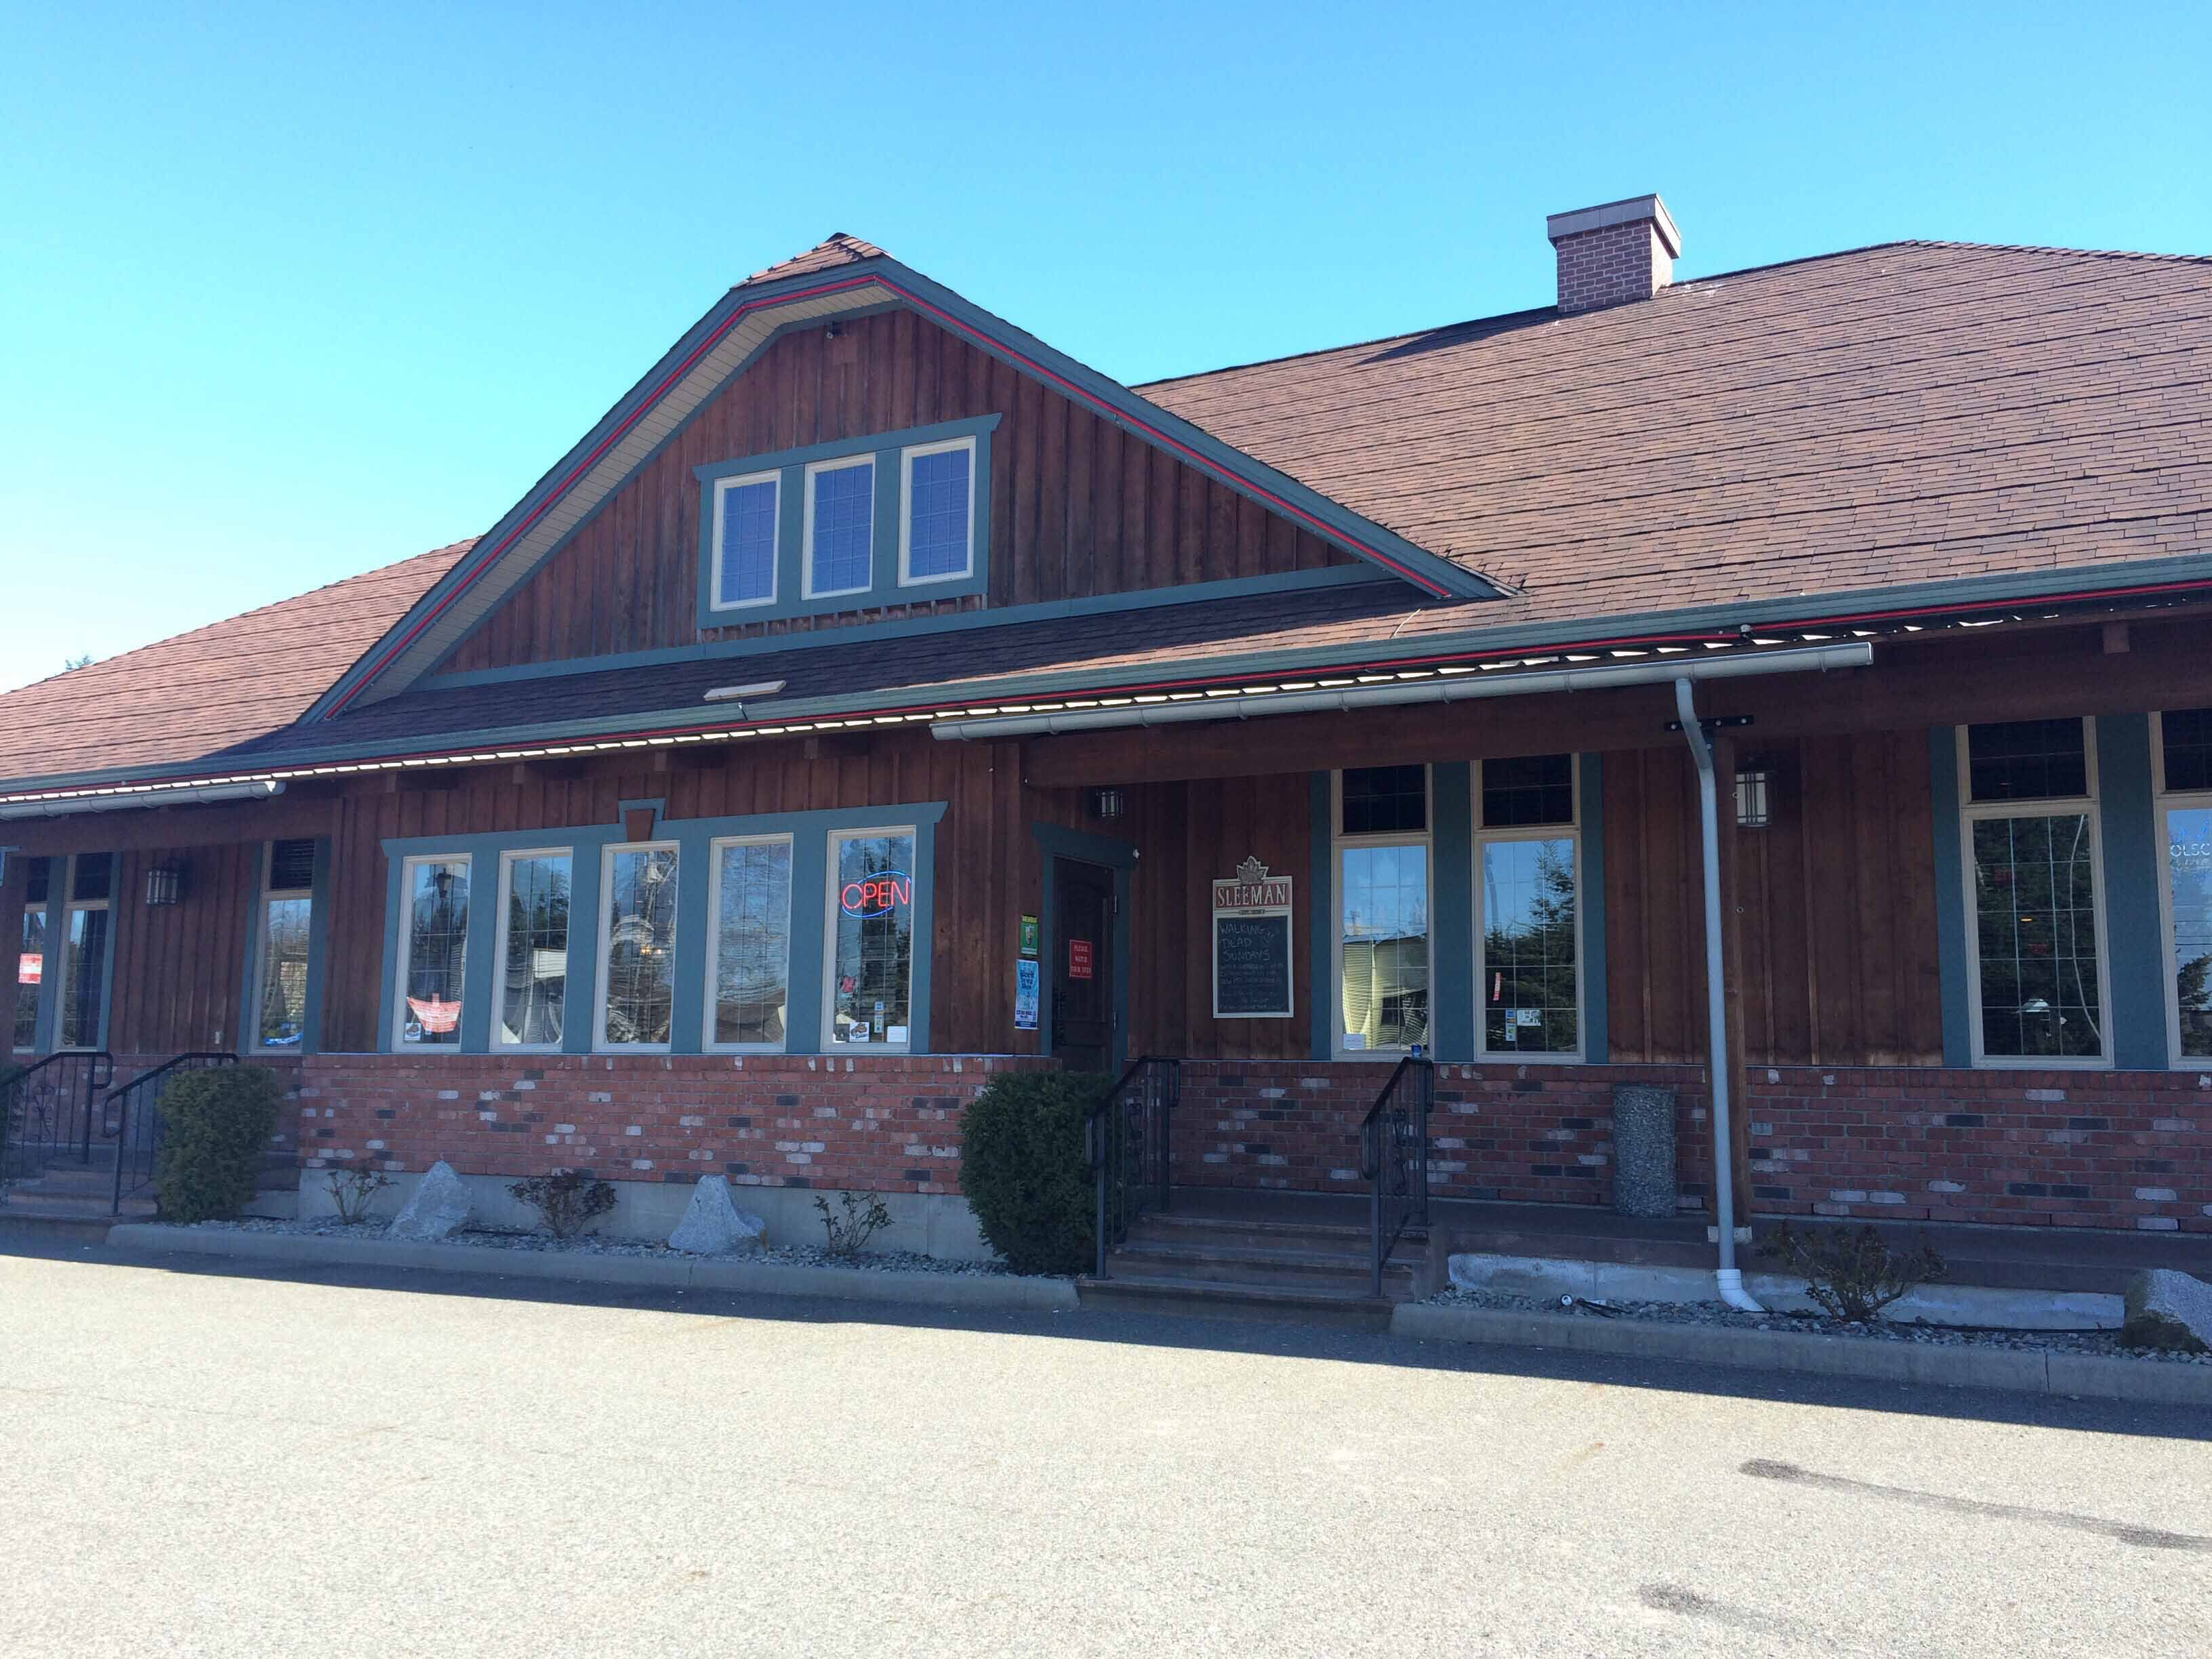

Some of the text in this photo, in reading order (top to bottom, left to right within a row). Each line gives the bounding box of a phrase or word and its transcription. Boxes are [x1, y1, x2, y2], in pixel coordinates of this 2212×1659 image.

[842, 878, 909, 909] OPEN
[1217, 884, 1286, 906] SLEEMAN
[1218, 922, 1265, 935] WALKING
[1219, 937, 1252, 949] DEAD
[1223, 949, 1271, 961] SUNDAYS
